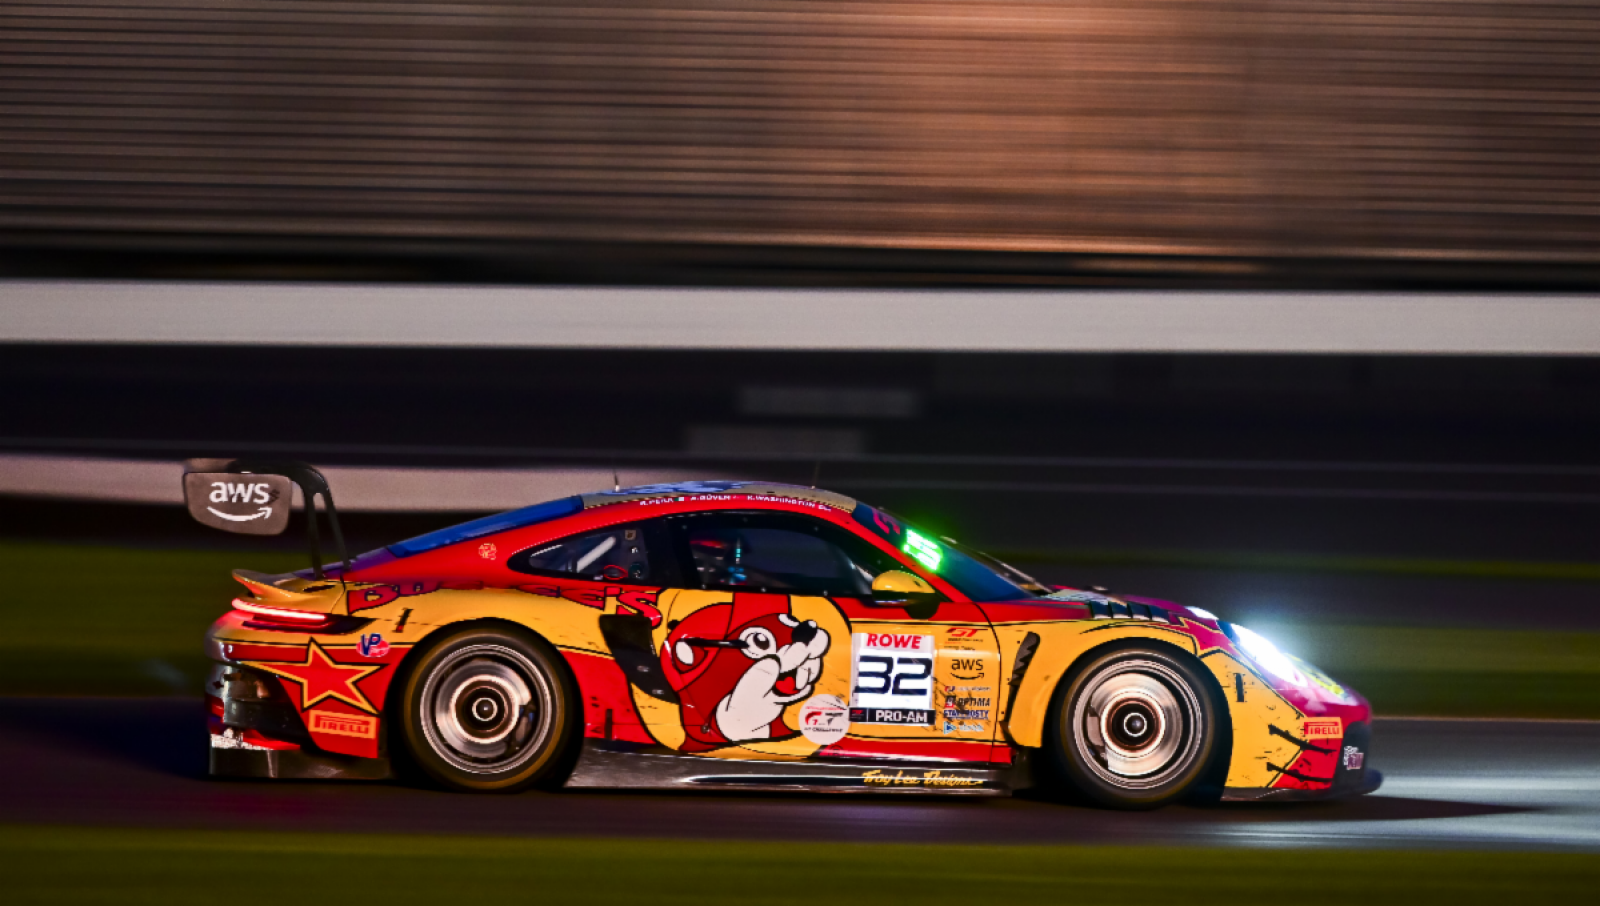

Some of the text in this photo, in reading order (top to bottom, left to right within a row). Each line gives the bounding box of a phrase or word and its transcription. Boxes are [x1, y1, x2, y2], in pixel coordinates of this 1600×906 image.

[209, 481, 270, 504] aws
[360, 633, 382, 656] VP
[866, 632, 922, 650] ROWE
[951, 658, 984, 671] aws
[853, 655, 933, 696] 32
[314, 714, 370, 735] PIRELLI
[875, 709, 929, 724] PRO-AM
[1303, 721, 1340, 735] PIRELLI
